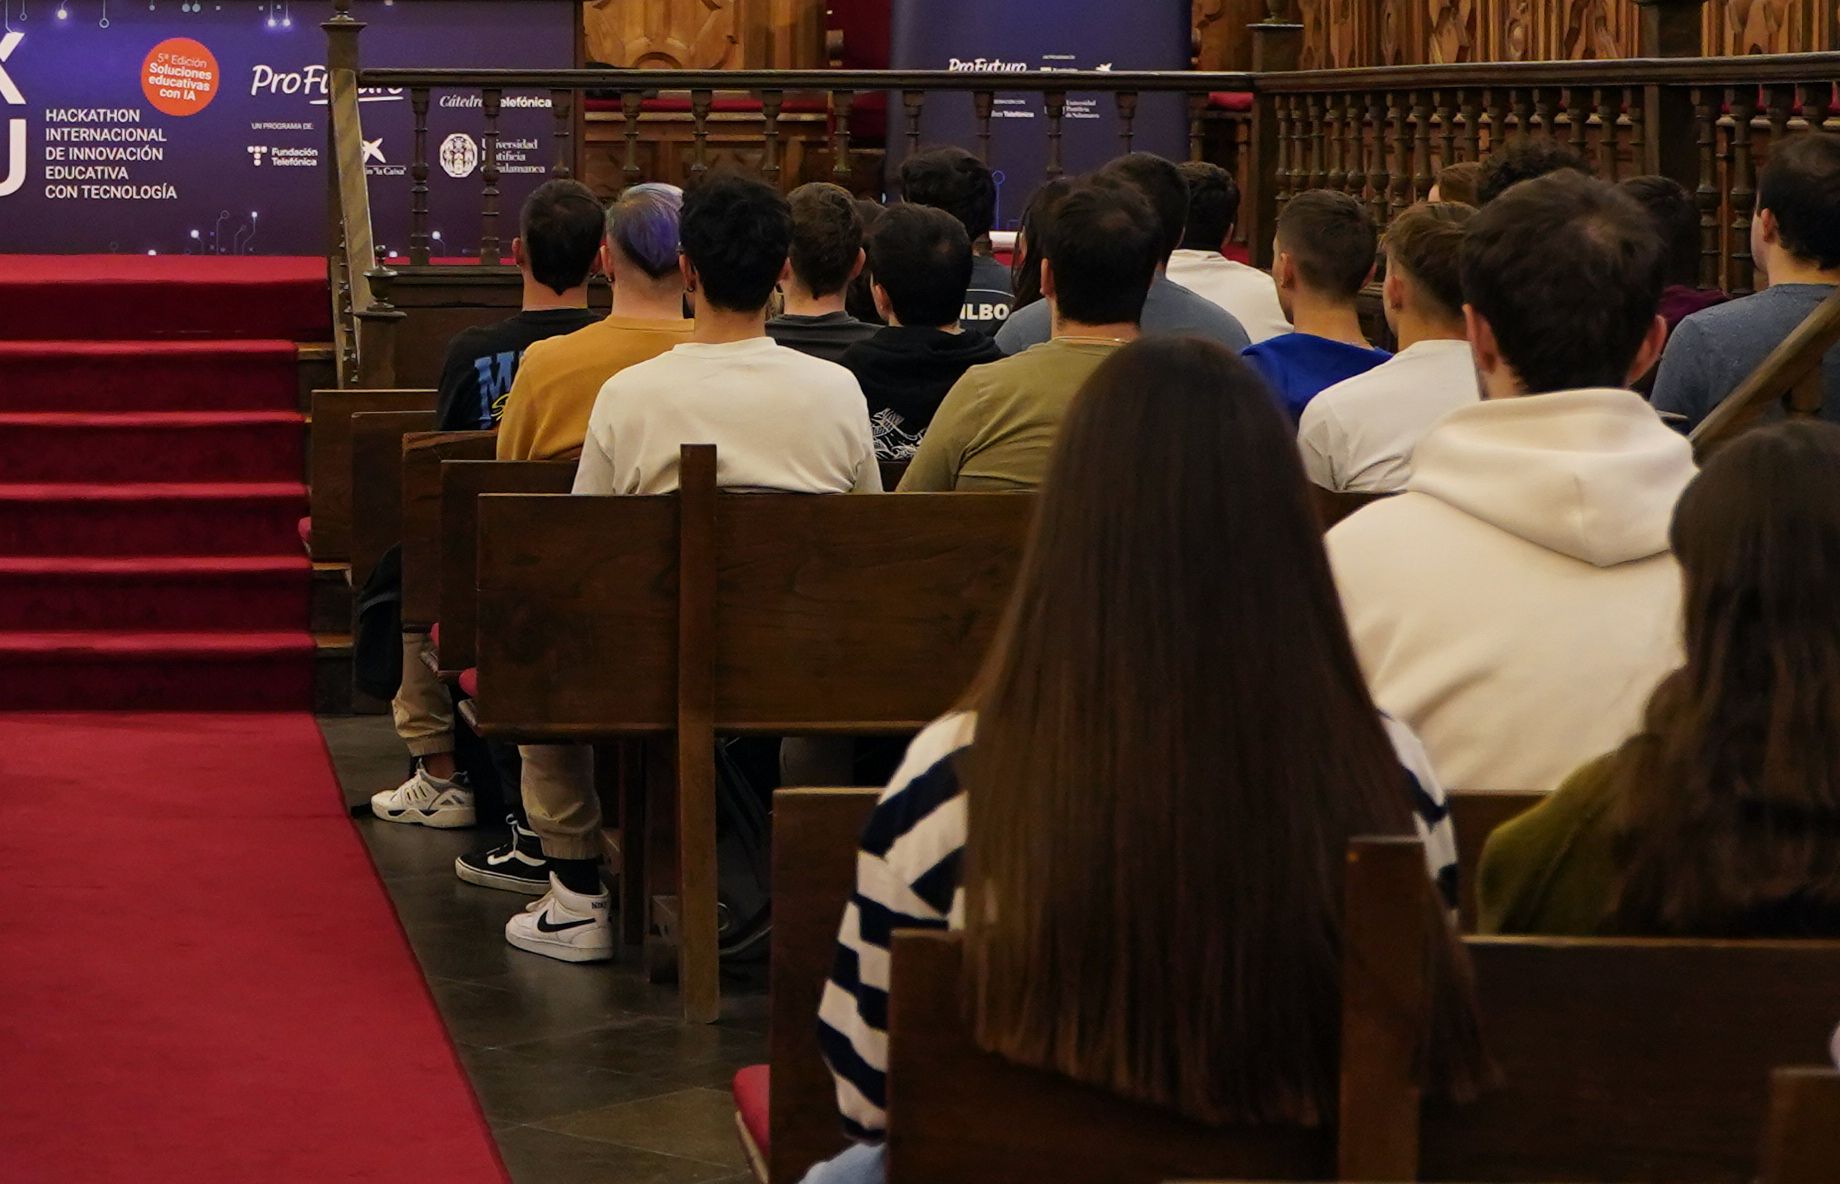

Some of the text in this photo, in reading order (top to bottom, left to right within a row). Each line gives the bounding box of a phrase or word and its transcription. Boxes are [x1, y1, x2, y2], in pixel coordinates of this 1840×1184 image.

[171, 54, 208, 68] Edición
[149, 62, 212, 80] Soluciones
[148, 75, 210, 91] educativas
[160, 88, 196, 101] con IA
[46, 109, 140, 122] HACKATHON
[263, 122, 302, 130] PROGRAMA
[46, 128, 167, 142] INTERNACIONAL
[46, 144, 163, 161] DE INNOVACIÓN
[271, 147, 318, 157] Fundación
[271, 157, 317, 167] Telefónica
[45, 166, 129, 180] EDUCATIVA
[45, 183, 178, 199] CON TECNOLOGÍA
